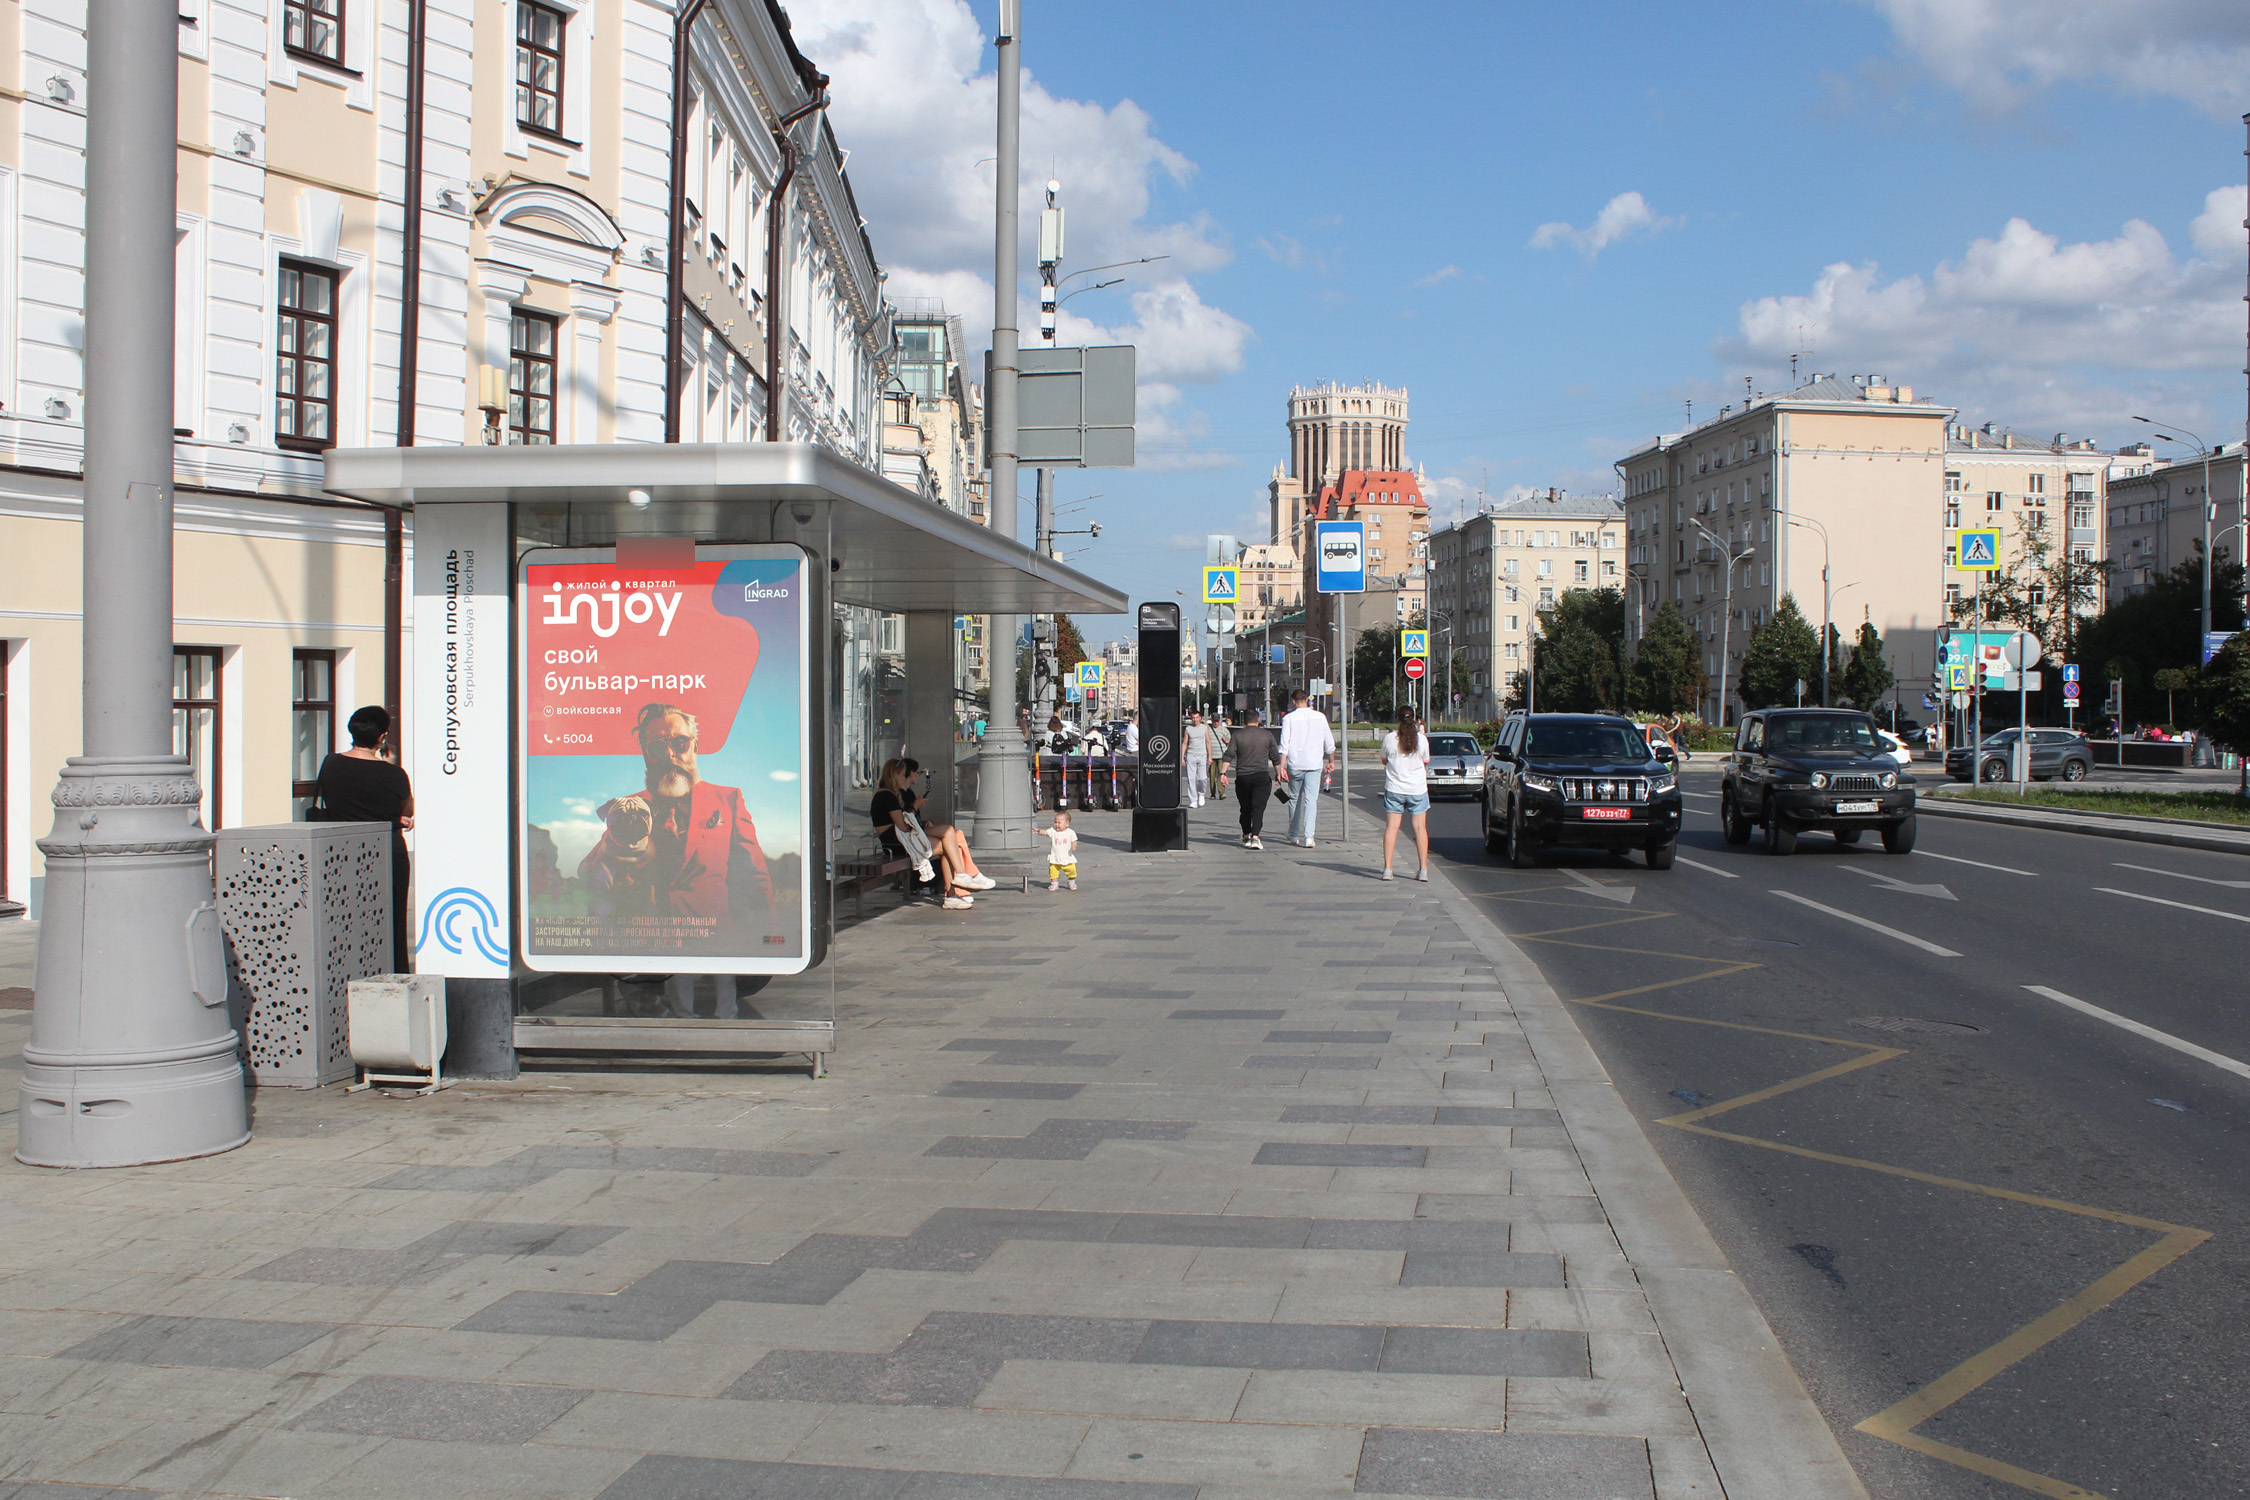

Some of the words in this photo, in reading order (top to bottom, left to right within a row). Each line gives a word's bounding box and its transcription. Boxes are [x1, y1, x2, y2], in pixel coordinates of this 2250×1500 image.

[463, 550, 474, 604] Ploschad
[566, 580, 607, 590] жилой
[625, 580, 676, 590] квартал
[446, 549, 460, 635] площадь
[748, 588, 789, 599] INGRAD
[543, 581, 683, 638] injoy
[463, 608, 477, 708] Serpukhovskaya
[544, 645, 599, 664] свой
[544, 671, 707, 695] бульвар-парк
[443, 641, 461, 776] Серпуховская
[556, 705, 622, 715] войковская
[535, 926, 581, 937] ЗАСТРОЙЩИК
[535, 937, 544, 946] НА
